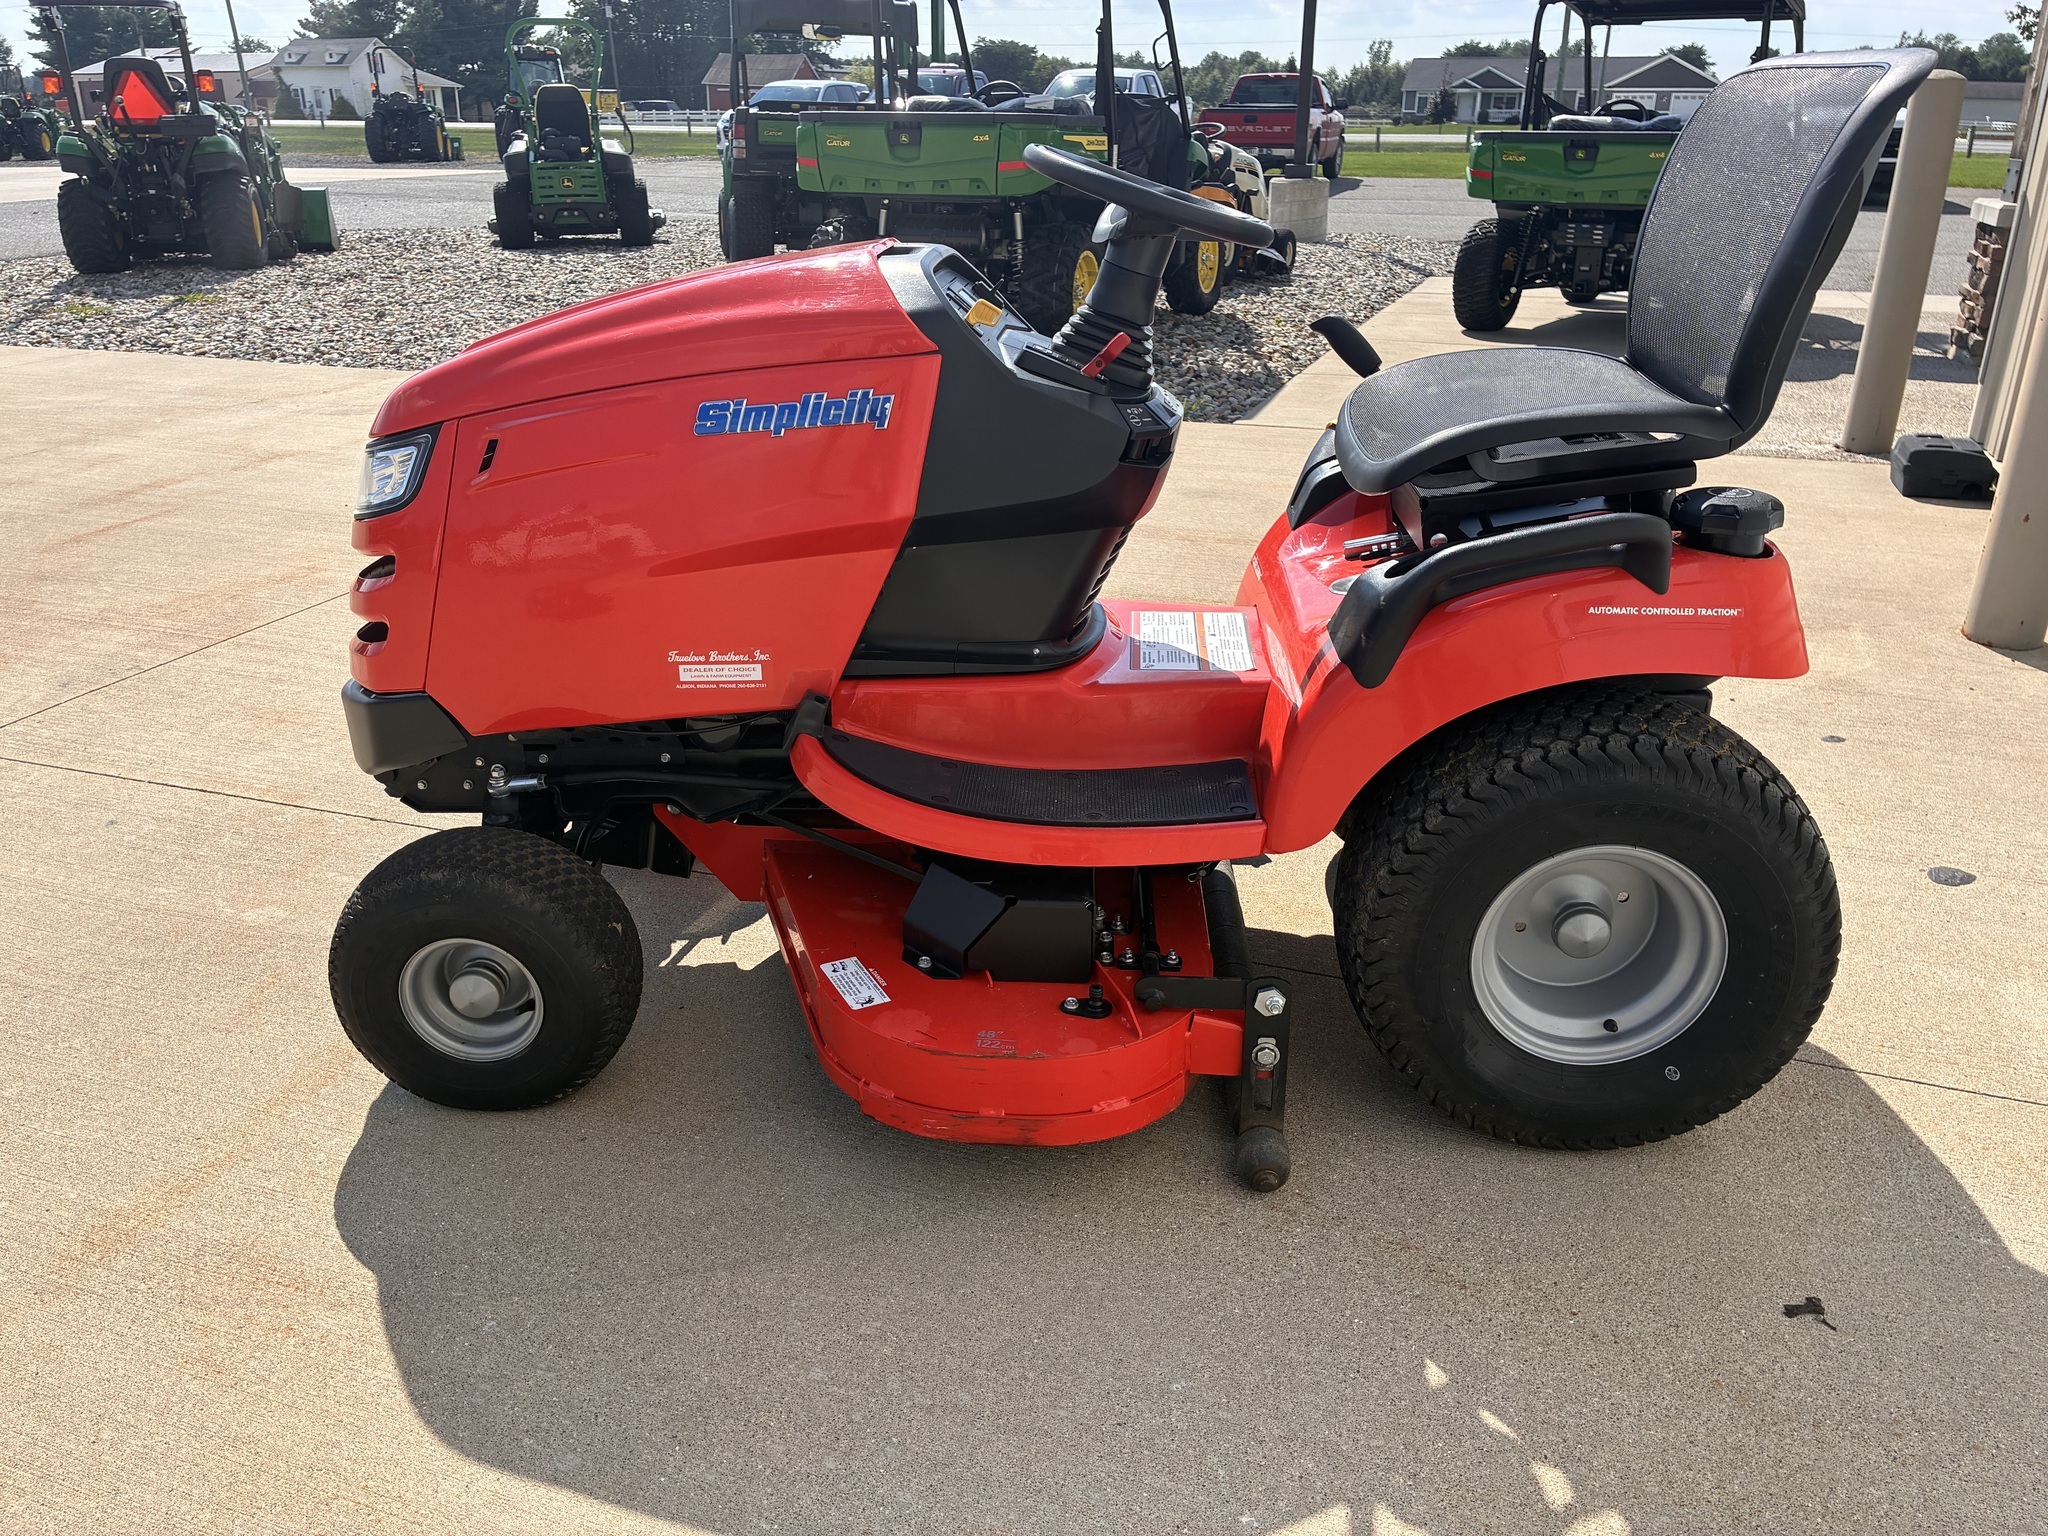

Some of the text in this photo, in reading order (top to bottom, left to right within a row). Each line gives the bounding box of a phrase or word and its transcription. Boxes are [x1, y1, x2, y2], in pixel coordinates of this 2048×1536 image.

[826, 139, 851, 147] GATOR
[693, 388, 895, 438] Simplicity
[1588, 606, 1639, 615] AUTOMATIC
[1641, 607, 1695, 616] CONTROLLED
[667, 650, 706, 663] Truelove
[708, 650, 753, 662] Brothers,
